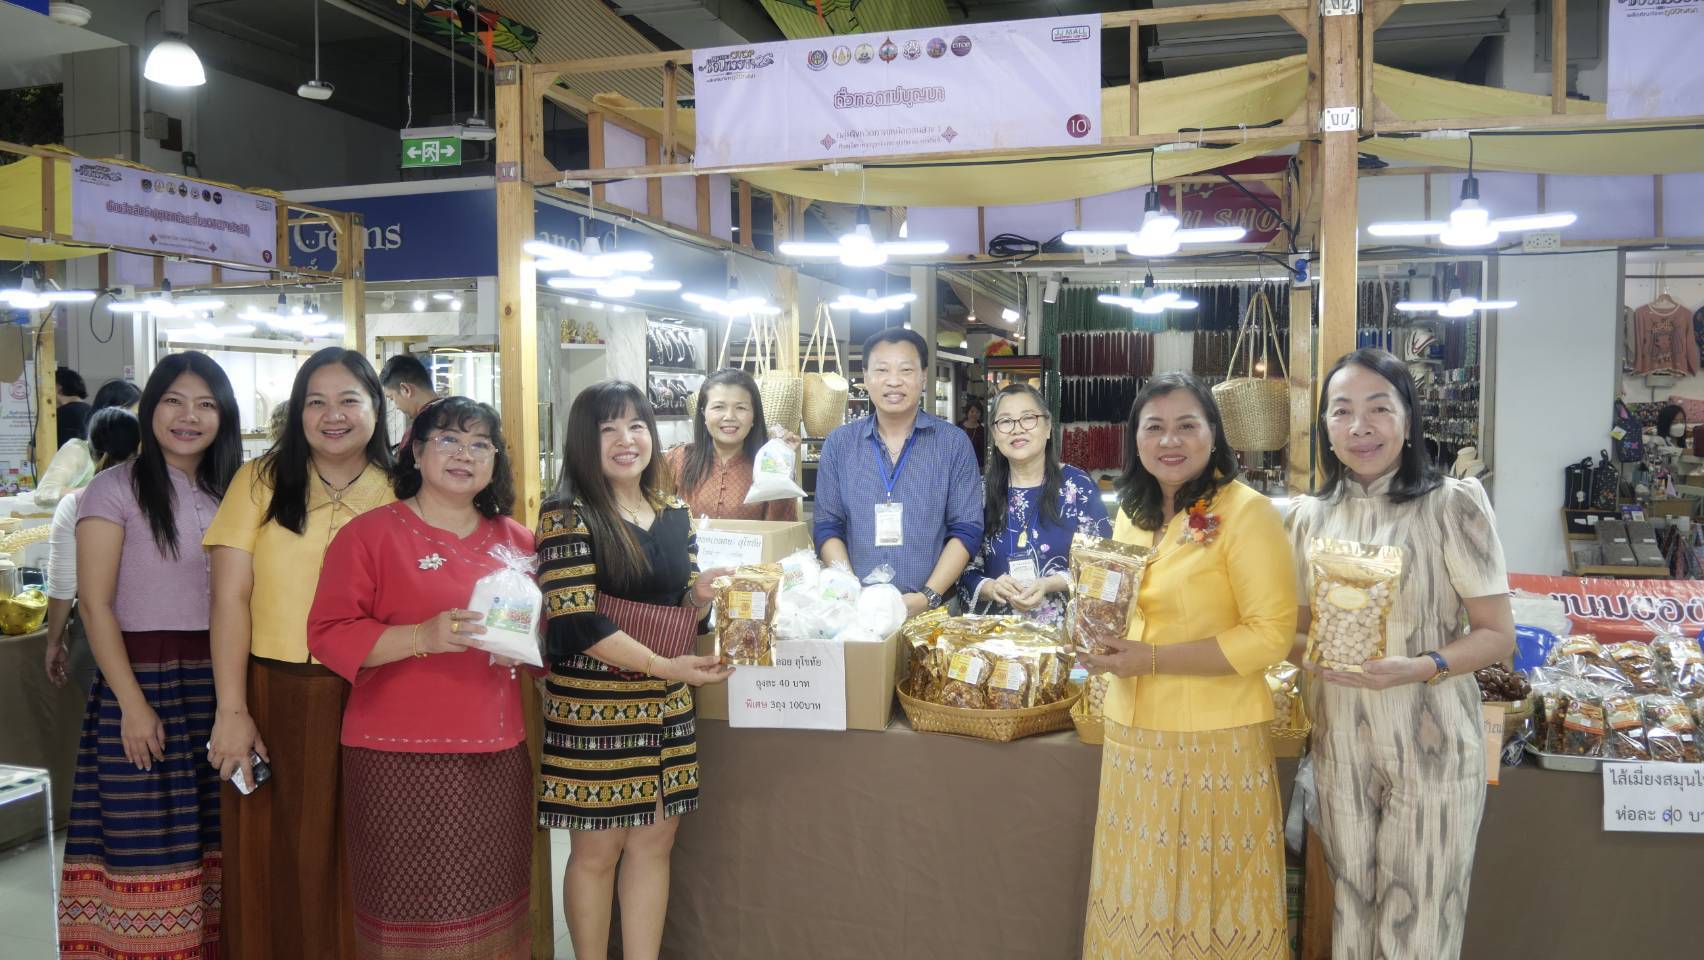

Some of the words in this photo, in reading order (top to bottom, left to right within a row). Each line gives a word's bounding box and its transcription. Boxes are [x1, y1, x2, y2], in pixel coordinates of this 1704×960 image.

[1072, 119, 1087, 133] 10
[795, 656, 822, 670] สุโขทัย
[756, 680, 776, 691] ถุงละ
[779, 680, 790, 688] 40
[793, 680, 810, 688] บาท
[745, 698, 768, 710] พิเศษ
[770, 701, 786, 712] 3ถุง
[789, 701, 821, 711] 100บาท
[1609, 765, 1704, 792] ไส้เมี่ยงสมุนไ
[1616, 805, 1656, 821] ห่อละ
